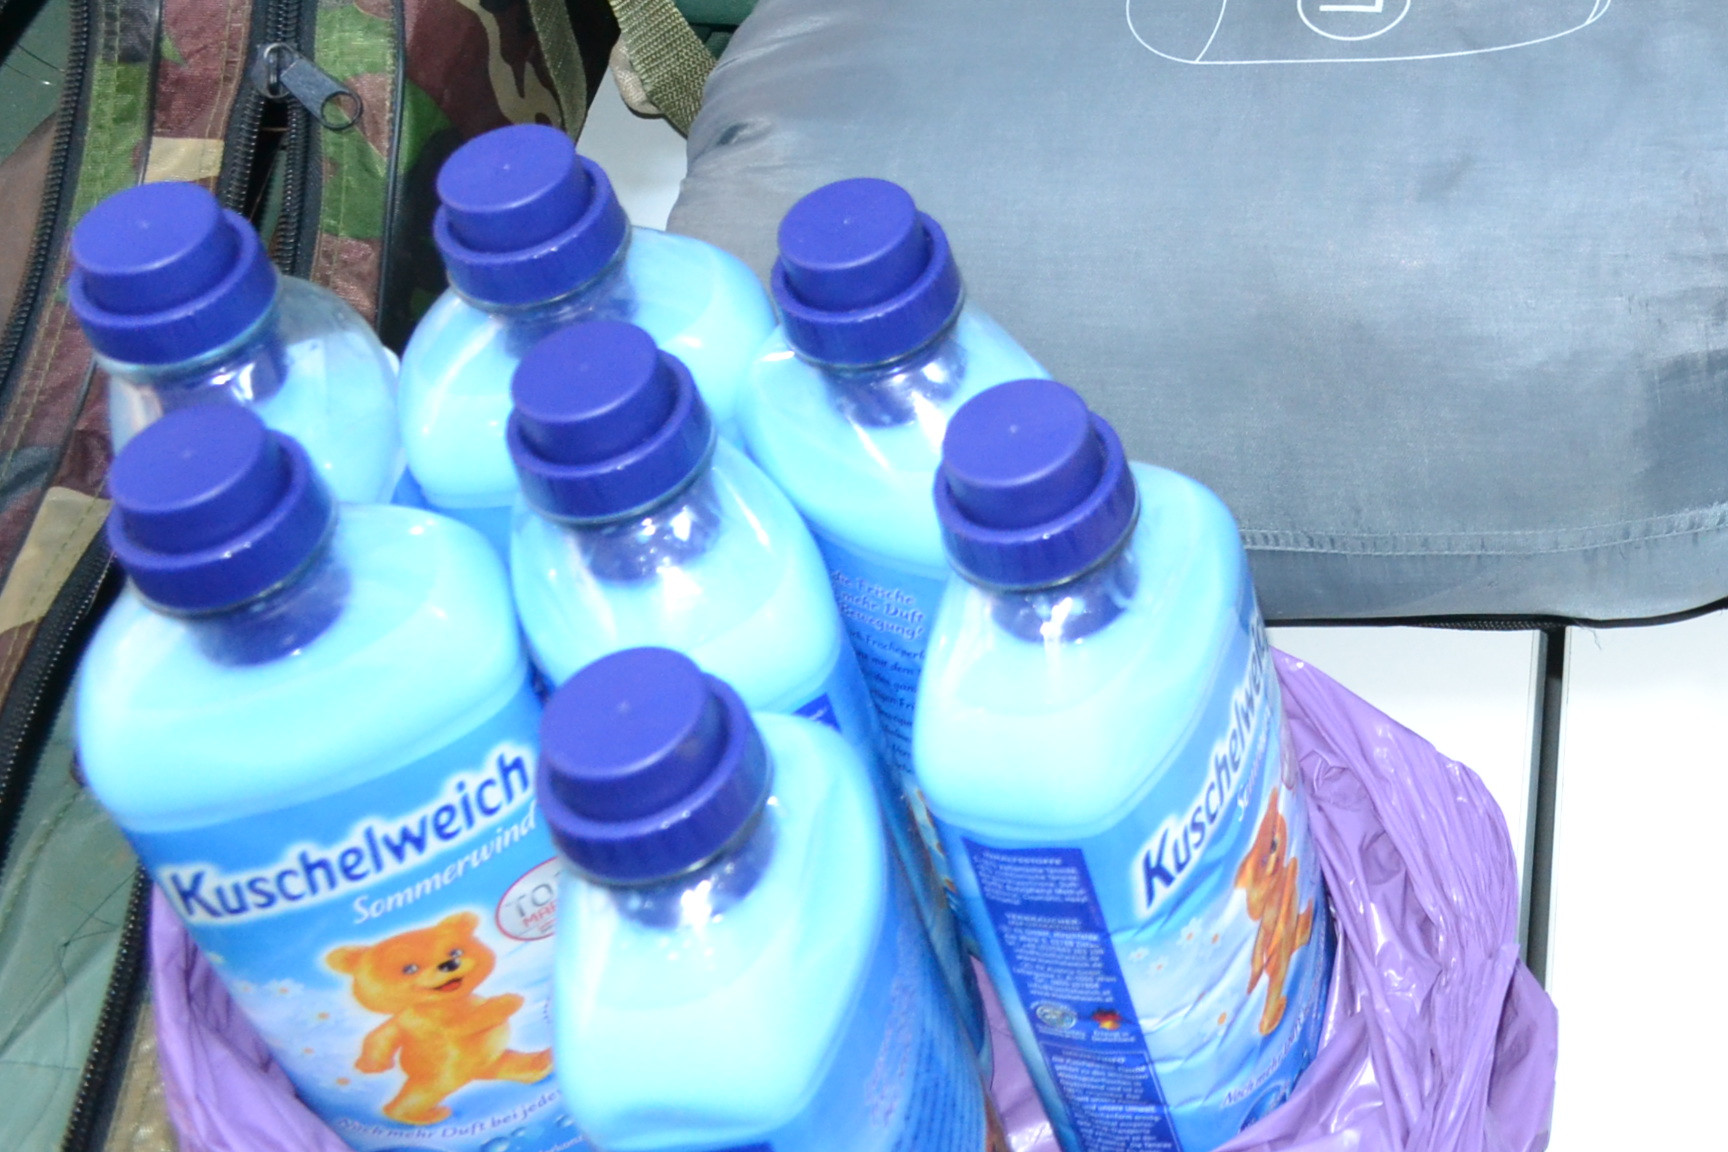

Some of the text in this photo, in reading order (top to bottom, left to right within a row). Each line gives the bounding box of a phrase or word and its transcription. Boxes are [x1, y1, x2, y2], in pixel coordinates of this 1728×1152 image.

[169, 751, 530, 918] Kuschelweich
[352, 799, 537, 925] Sommerwind
[505, 876, 557, 917] TO
[440, 1120, 488, 1140] Duft
[490, 1111, 518, 1129] bei
